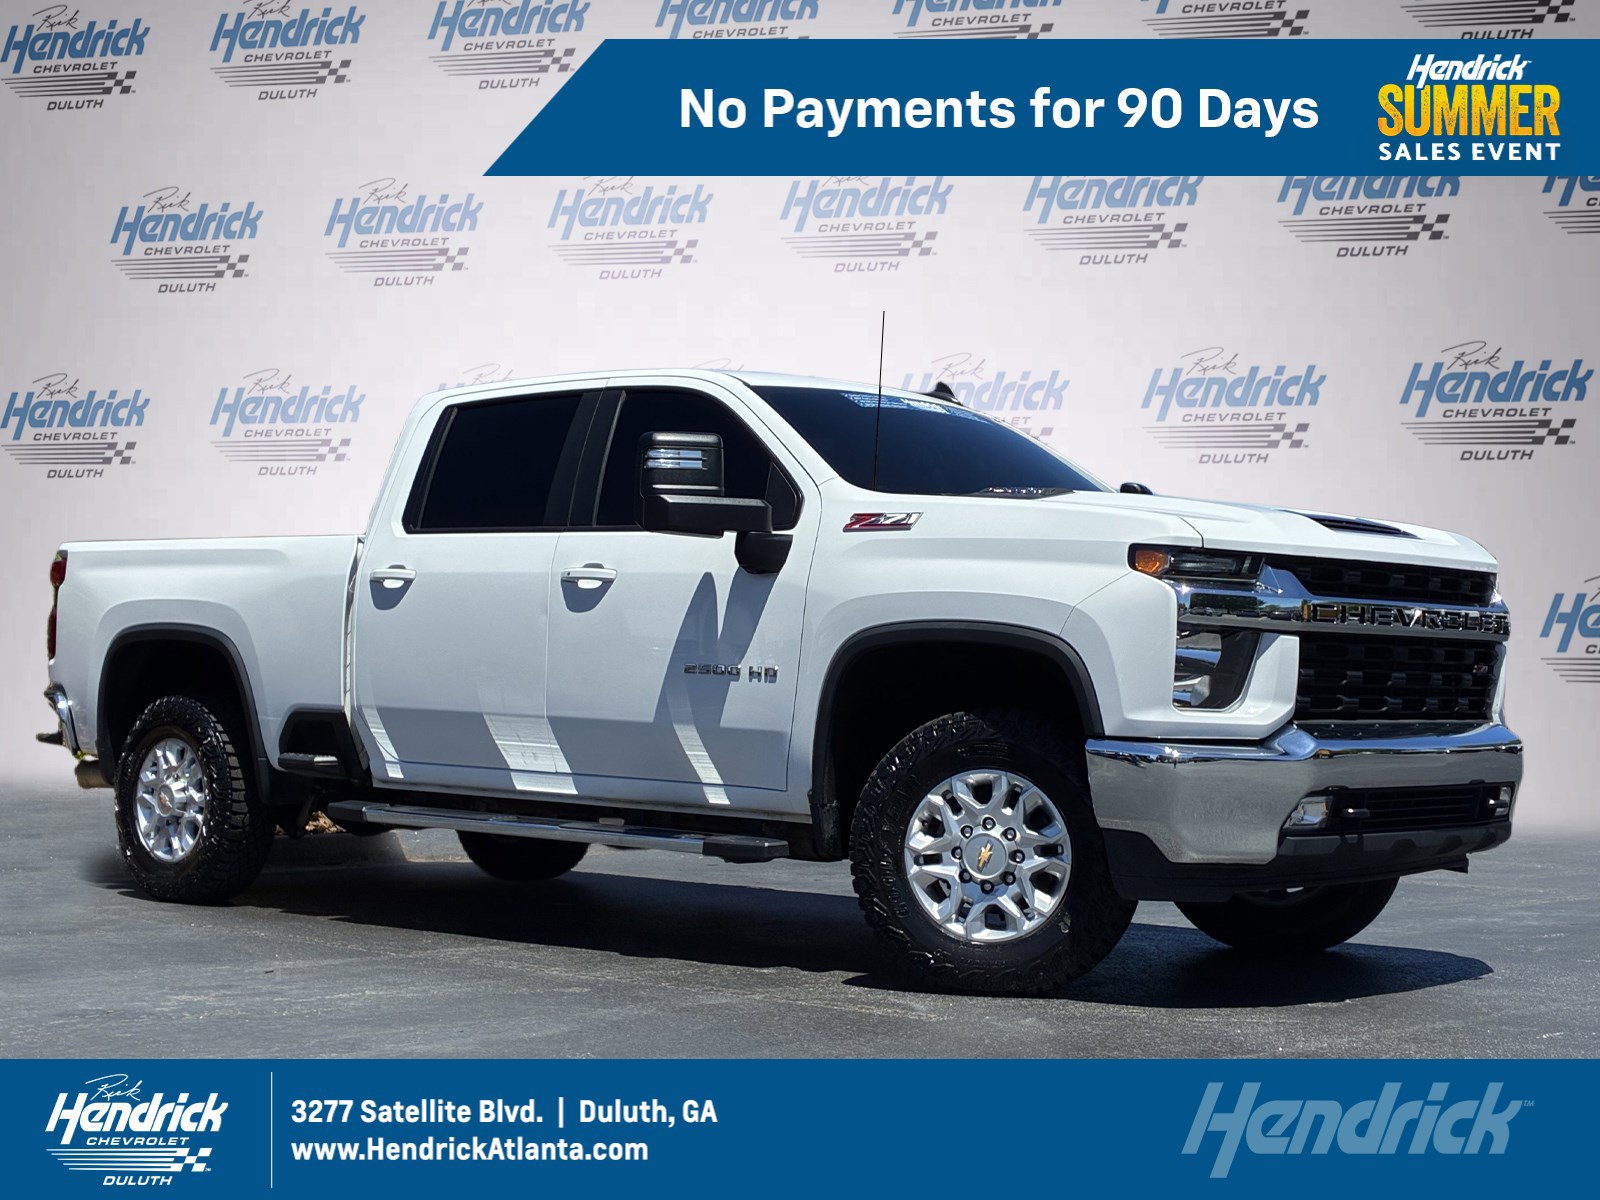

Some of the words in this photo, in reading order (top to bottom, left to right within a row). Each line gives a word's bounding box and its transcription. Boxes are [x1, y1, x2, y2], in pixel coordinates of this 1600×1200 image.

[1182, 0, 1287, 14] CHEVROLET
[428, 0, 590, 51] Hendrick
[931, 13, 1032, 27] CHEVROLET
[209, 5, 366, 63] Hendrick
[693, 26, 788, 39] CHEVROLET
[0, 18, 151, 74] Hendrick
[463, 38, 556, 51] CHEVROLET
[244, 50, 332, 63] CHEVROLET
[33, 61, 118, 73] CHEVROLET
[478, 77, 540, 90] DULUTH
[258, 88, 318, 101] DULUTH
[46, 99, 104, 111] DULUTH
[779, 175, 954, 233] Hendrick
[1022, 175, 1204, 225] Hendrick
[547, 184, 714, 241] Hendrick
[1318, 203, 1427, 217] CHEVROLET
[323, 193, 484, 248] Hendrick
[1063, 212, 1166, 225] CHEVROLET
[110, 201, 264, 256] Hendrick
[818, 221, 917, 234] CHEVROLET
[584, 229, 678, 241] CHEVROLET
[359, 237, 450, 249] CHEVROLET
[144, 244, 230, 256] CHEVROLET
[1336, 245, 1409, 258] DULUTH
[1079, 253, 1148, 266] DULUTH
[834, 261, 900, 274] DULUTH
[373, 275, 435, 287] DULUTH
[599, 268, 663, 281] DULUTH
[158, 282, 216, 294] DULUTH
[901, 370, 1071, 412] ndrick
[1140, 364, 1327, 422] Hendrick
[1399, 359, 1595, 418] Hendrick
[0, 386, 151, 441] Hendrick
[209, 384, 366, 438] Hendrick
[1181, 411, 1287, 423] CHEVROLET
[1442, 407, 1552, 419] CHEVROLET
[33, 431, 118, 441] CHEVROLET
[244, 428, 332, 438] CHEVROLET
[1198, 453, 1269, 464] DULUTH
[1459, 449, 1534, 461] DULUTH
[46, 468, 104, 479] DULUTH
[257, 465, 318, 477] DULUTH
[843, 512, 923, 532] Z71
[1306, 602, 1510, 635] CHEVROLET
[684, 664, 740, 676] 2500
[748, 665, 778, 680] HD
